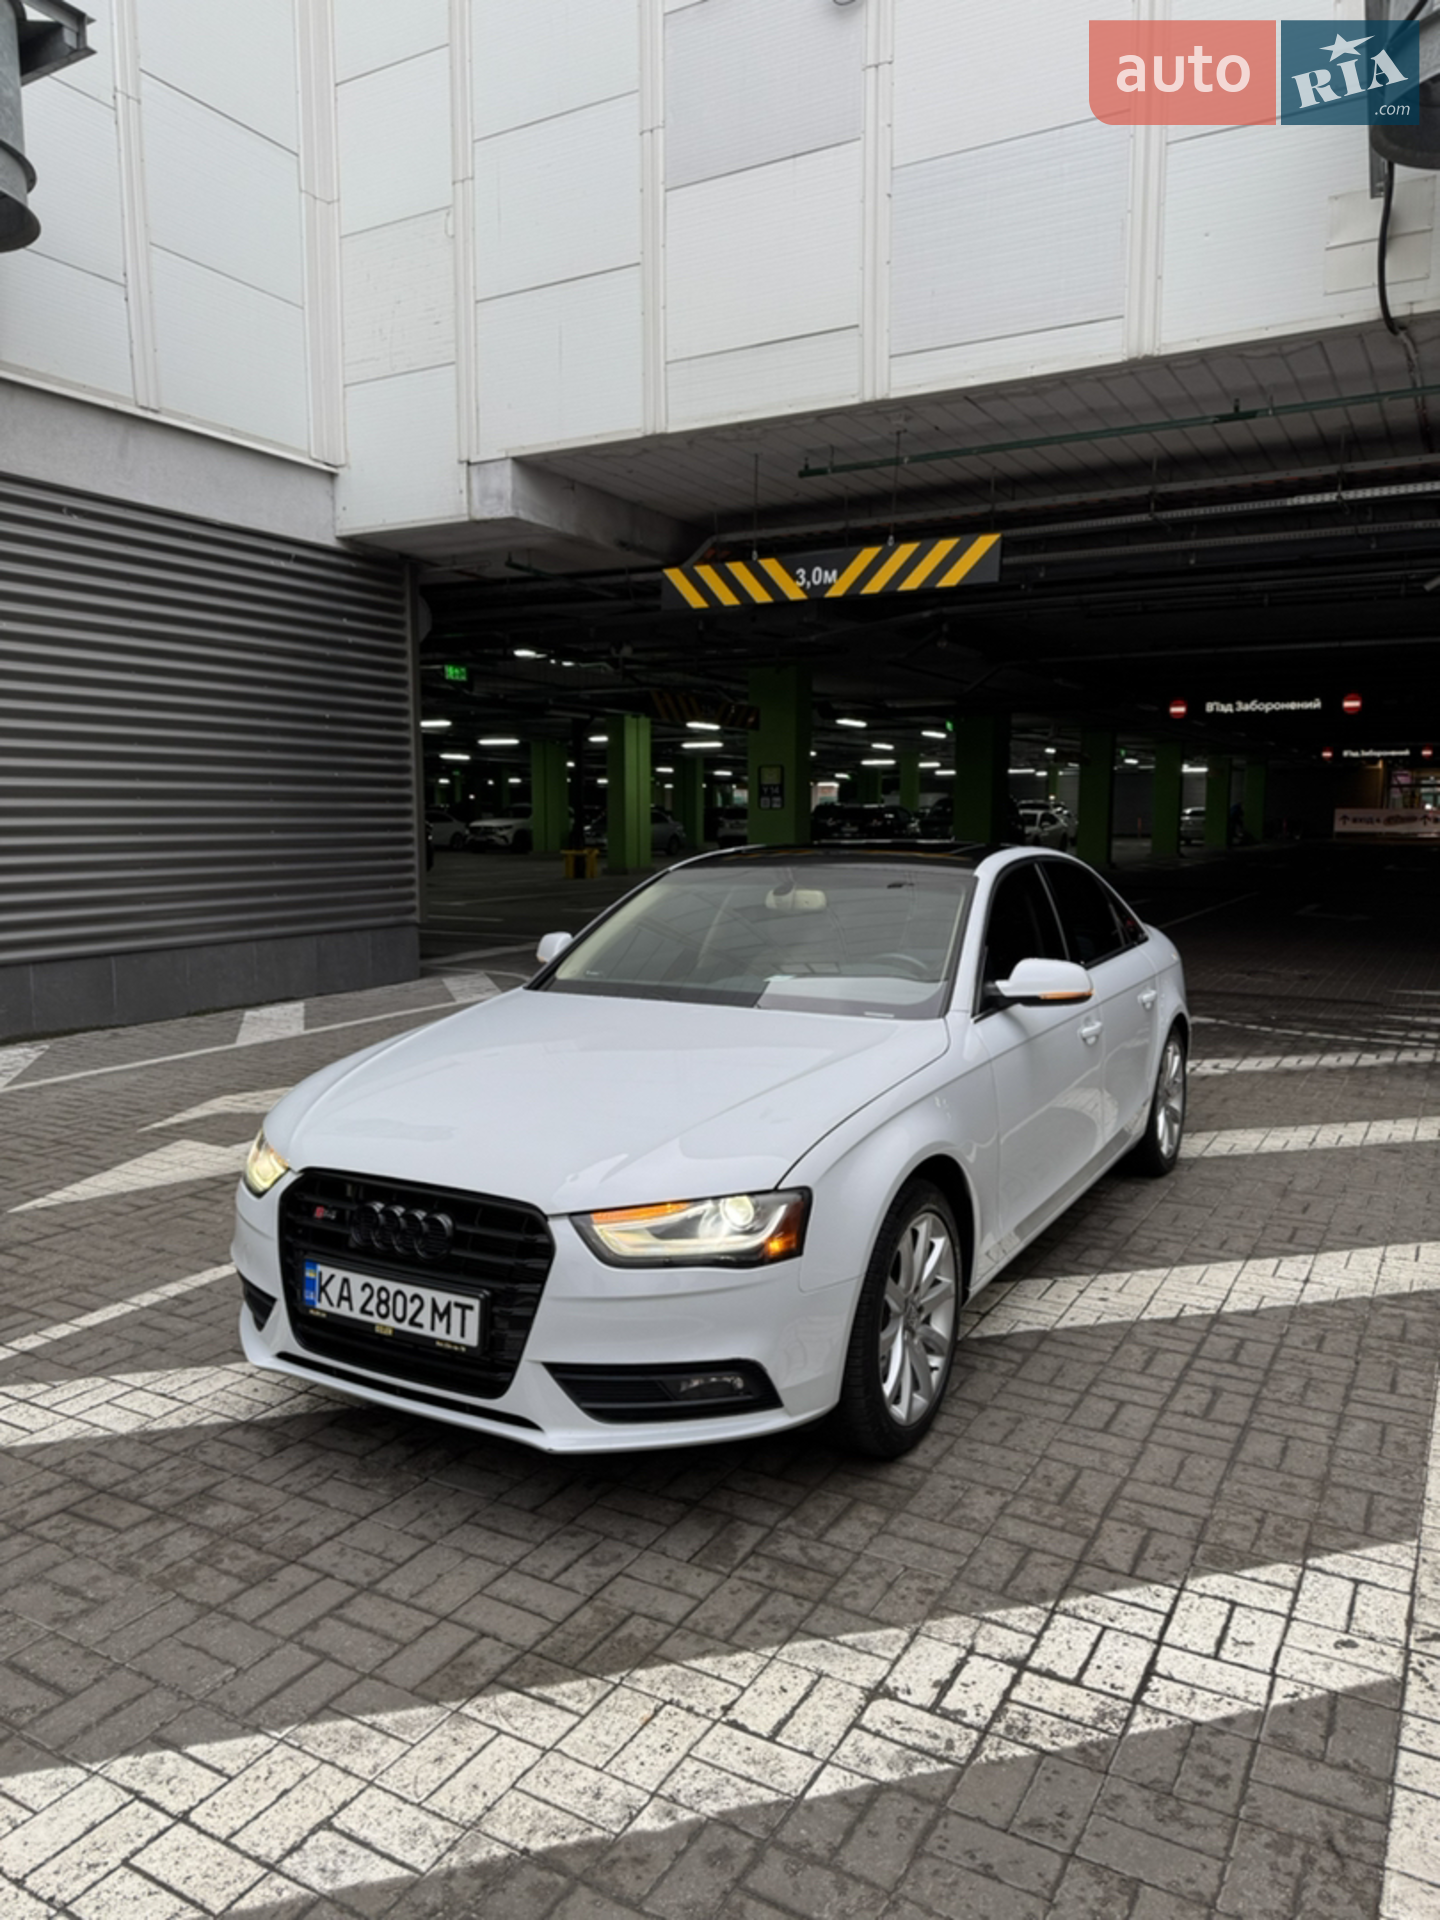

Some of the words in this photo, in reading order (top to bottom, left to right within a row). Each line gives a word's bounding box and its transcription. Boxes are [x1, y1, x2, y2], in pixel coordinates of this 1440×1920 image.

[796, 566, 837, 587] 3,0м
[1235, 697, 1322, 714] Заборонений
[317, 1270, 354, 1312] KA
[359, 1282, 425, 1328] 2802
[431, 1297, 474, 1339] MT
